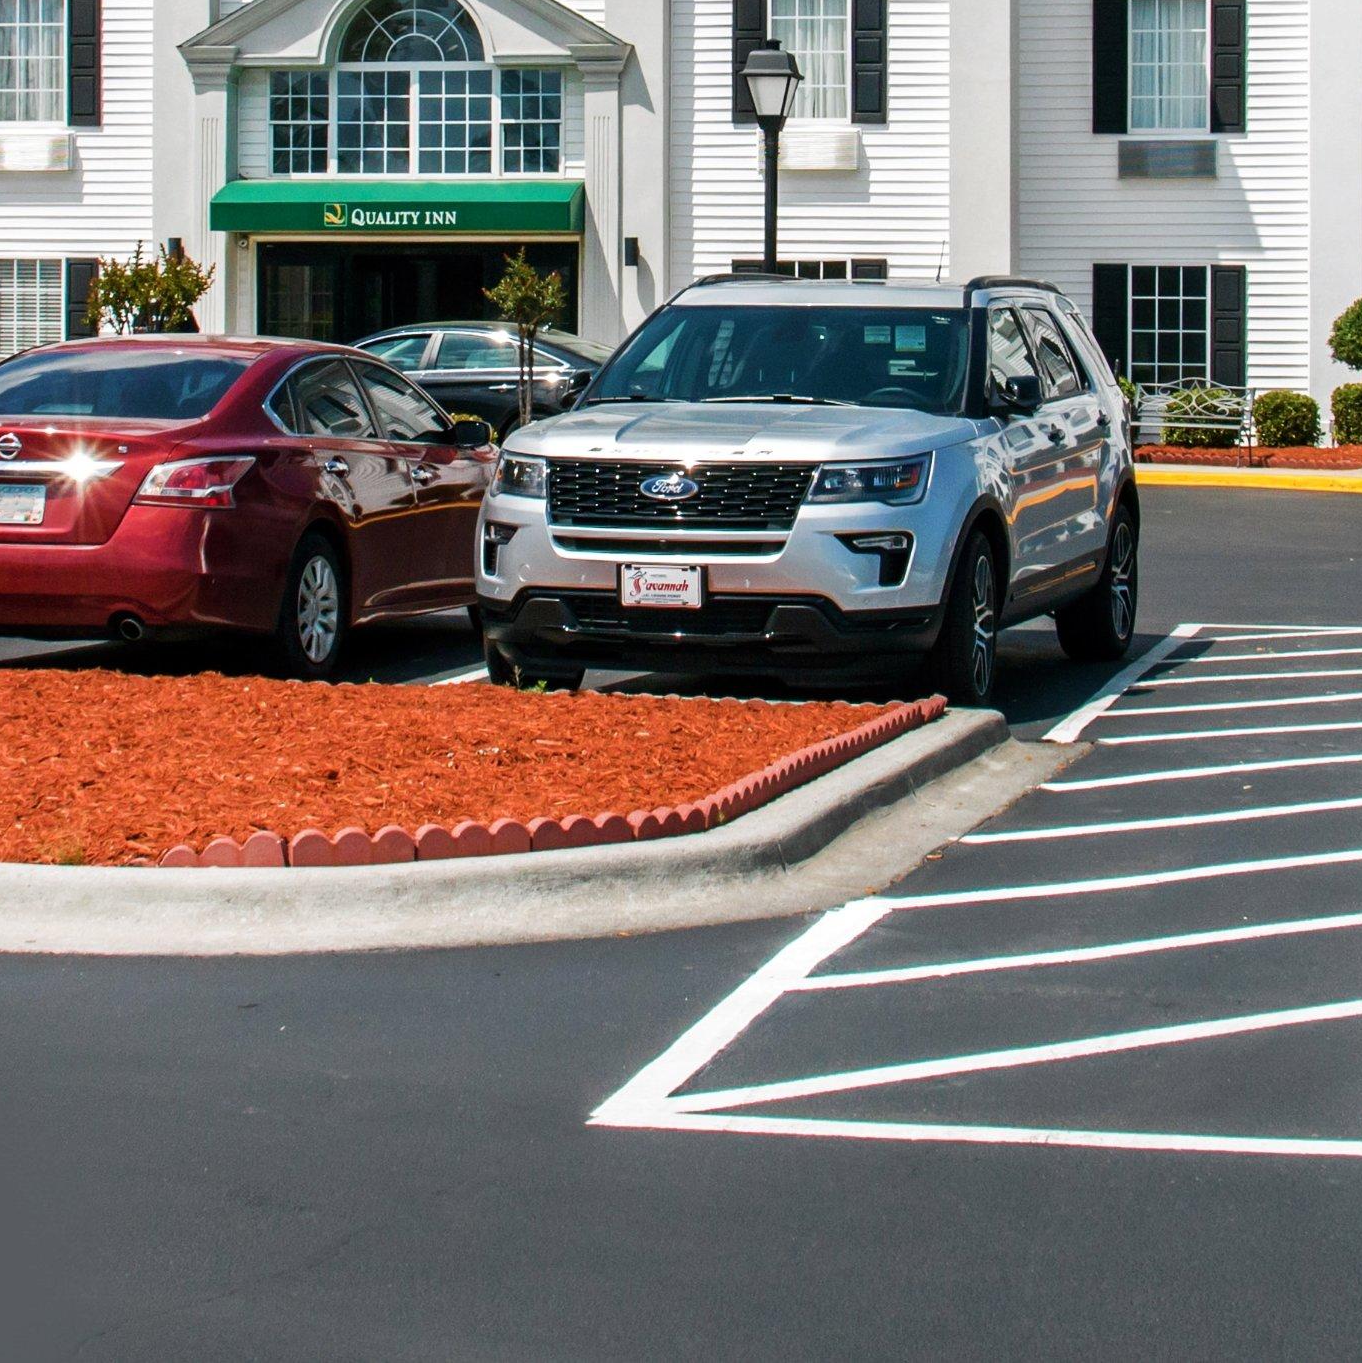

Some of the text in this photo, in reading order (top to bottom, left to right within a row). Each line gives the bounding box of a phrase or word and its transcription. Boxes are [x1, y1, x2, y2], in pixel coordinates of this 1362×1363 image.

[351, 208, 457, 226] QUALITY INN
[651, 479, 684, 493] Ford
[630, 577, 689, 596] Savannah
